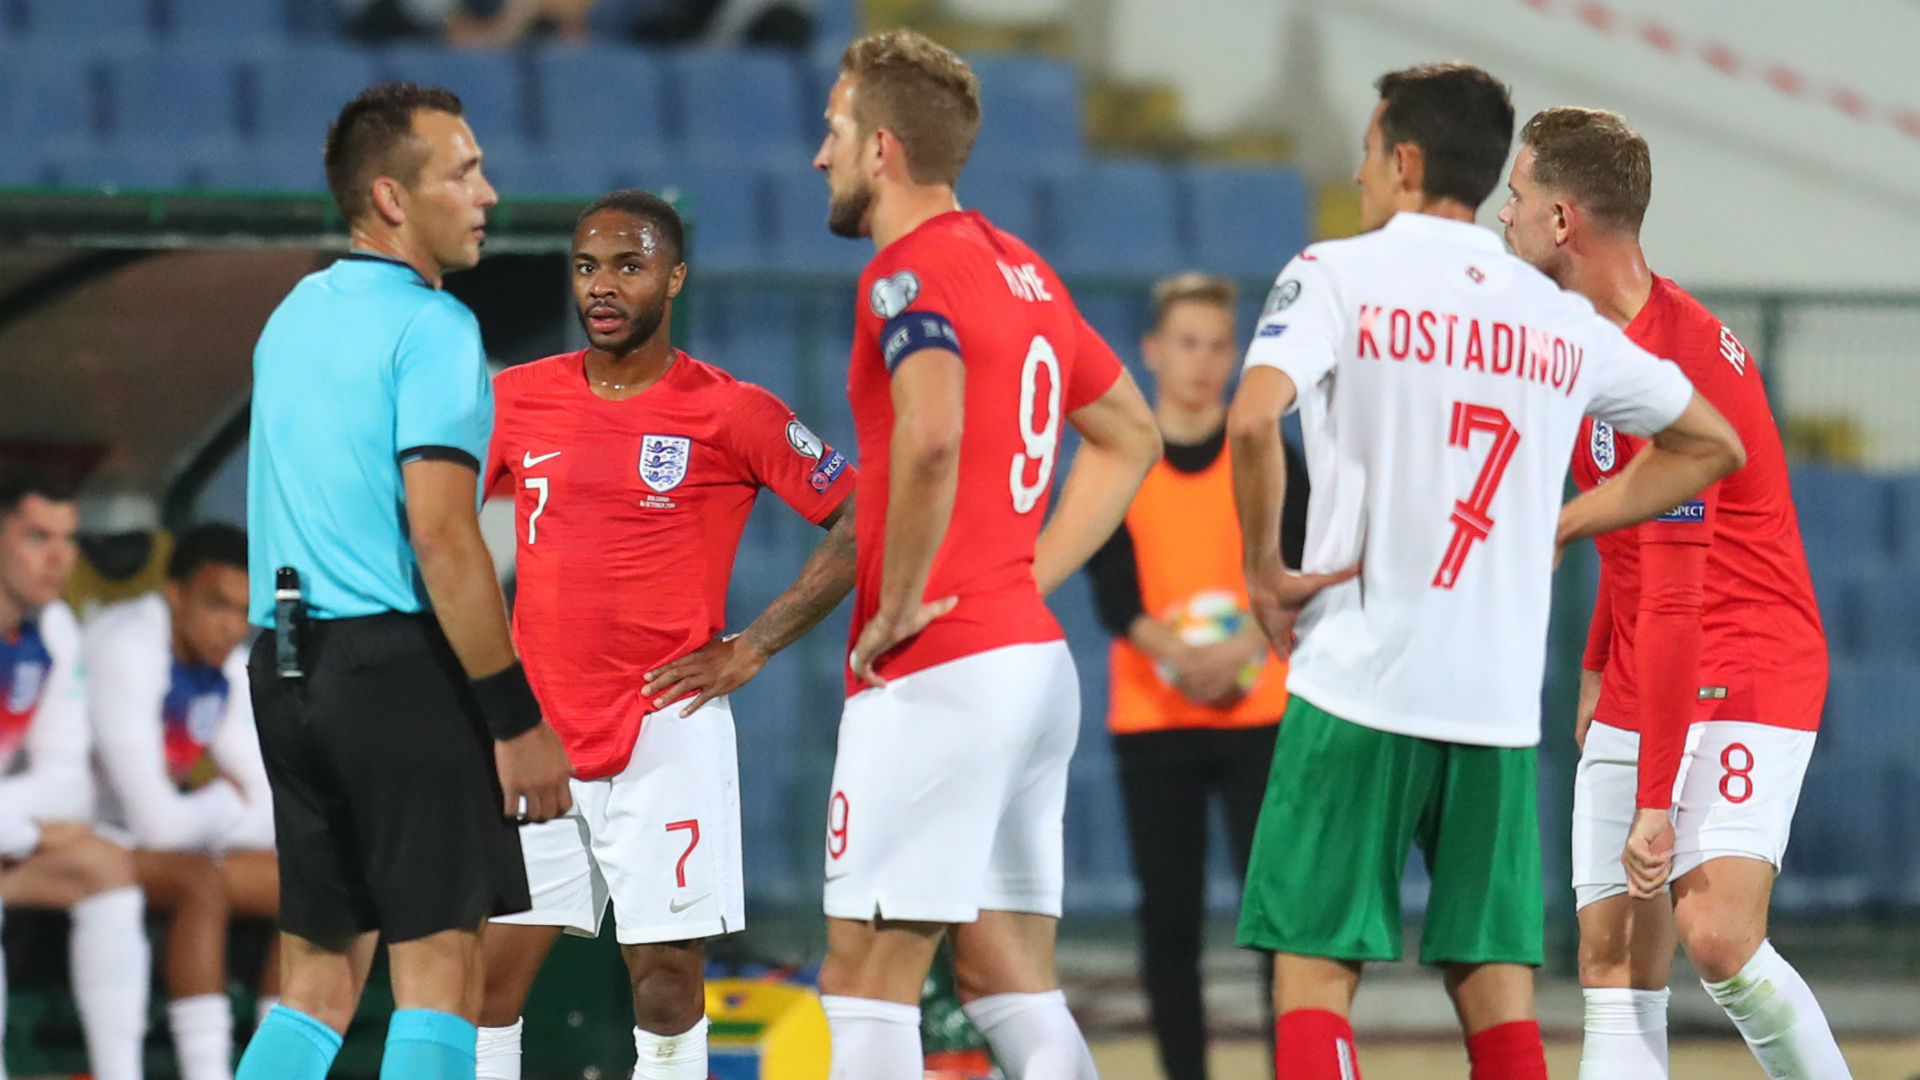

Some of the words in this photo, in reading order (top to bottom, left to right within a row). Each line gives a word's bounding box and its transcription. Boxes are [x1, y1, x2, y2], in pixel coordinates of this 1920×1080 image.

[1357, 304, 1583, 397] KOSTADINOV
[1010, 336, 1062, 514] 9
[524, 477, 548, 544] 7
[1431, 401, 1521, 590] 7
[1719, 742, 1754, 804] 8
[665, 819, 700, 888] 7
[828, 791, 849, 860] 9
